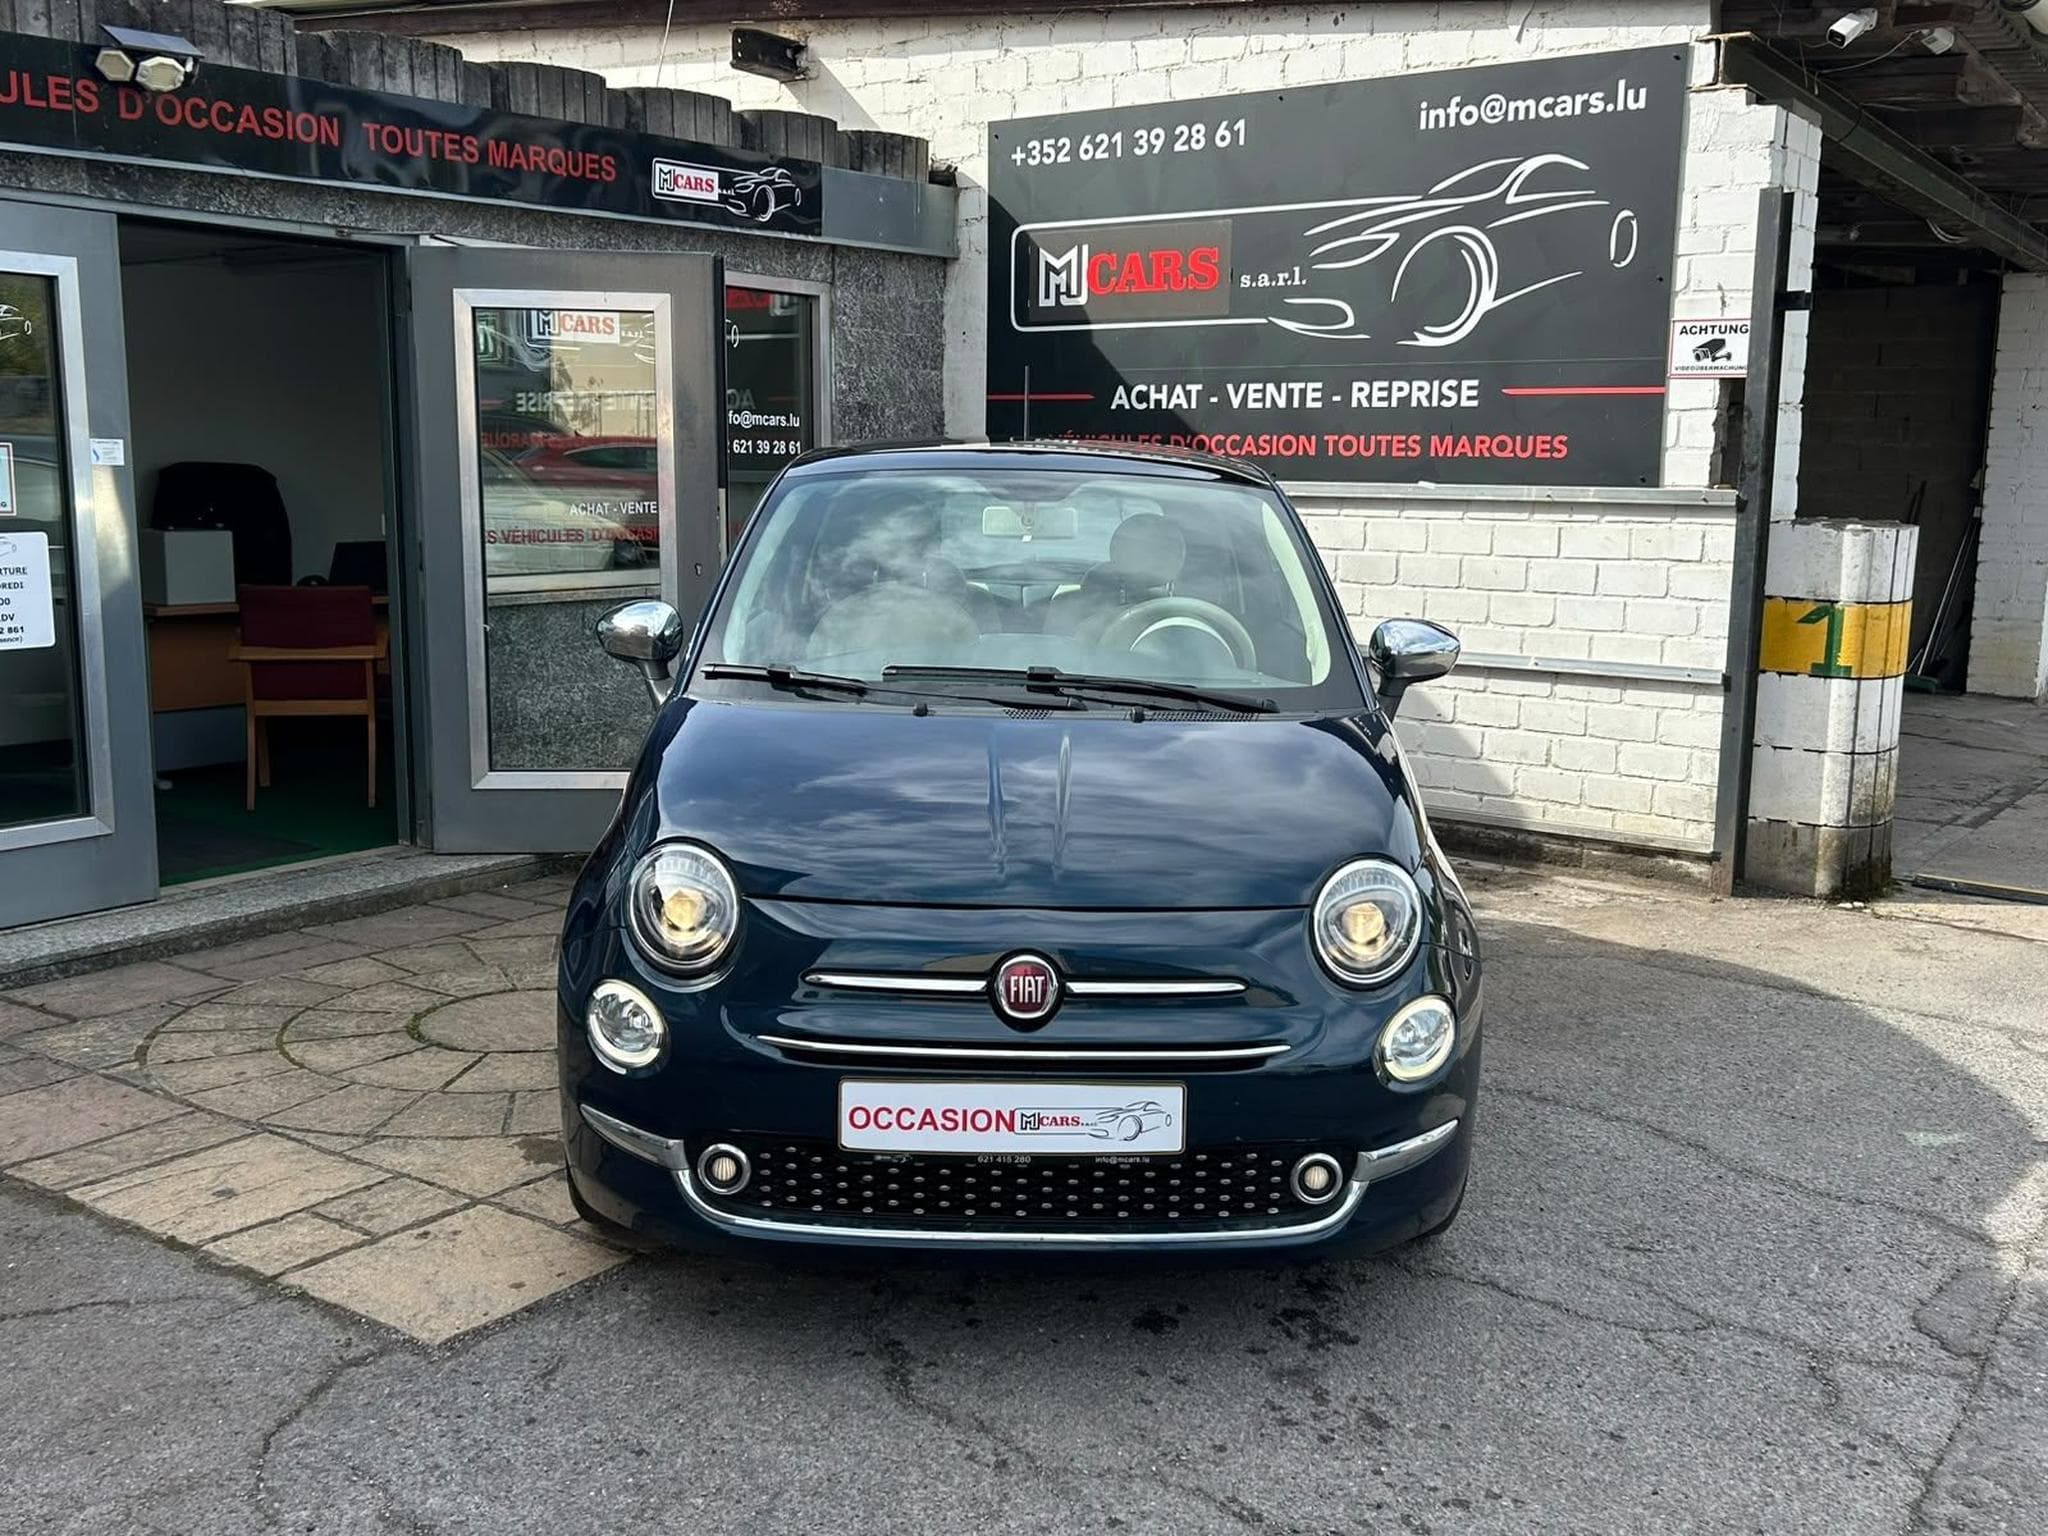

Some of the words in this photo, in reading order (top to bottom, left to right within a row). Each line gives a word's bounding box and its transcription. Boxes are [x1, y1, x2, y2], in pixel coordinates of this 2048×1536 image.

[1419, 79, 1647, 130] info@mcars.lu
[118, 86, 339, 147] D'OCCASION
[362, 122, 480, 164] TOUTES
[488, 140, 616, 183] MARQUES
[1011, 137, 1071, 166] +352
[1079, 131, 1122, 160] 621
[1133, 127, 1165, 156] 39
[1174, 123, 1206, 152] 28
[1214, 118, 1246, 148] 61
[1239, 265, 1307, 288] s.a.r.l.
[1679, 324, 1749, 336] ACHTUNG
[1110, 384, 1203, 410] ACHAT
[1227, 382, 1323, 409] VENTE
[1350, 379, 1479, 408] REPRISE
[728, 410, 800, 429] fo@mcars.lu
[733, 440, 753, 454] 621
[757, 440, 770, 454] 39
[773, 440, 787, 455] 28
[789, 440, 801, 455] 61
[1324, 434, 1421, 458] TOUTES
[1429, 433, 1569, 459] MARQUES
[570, 503, 609, 516] ACHAT
[620, 501, 658, 515] VENTE
[1797, 604, 1853, 678] 1
[1010, 975, 1046, 1003] FIAT
[848, 1105, 1015, 1133] OCCASION
